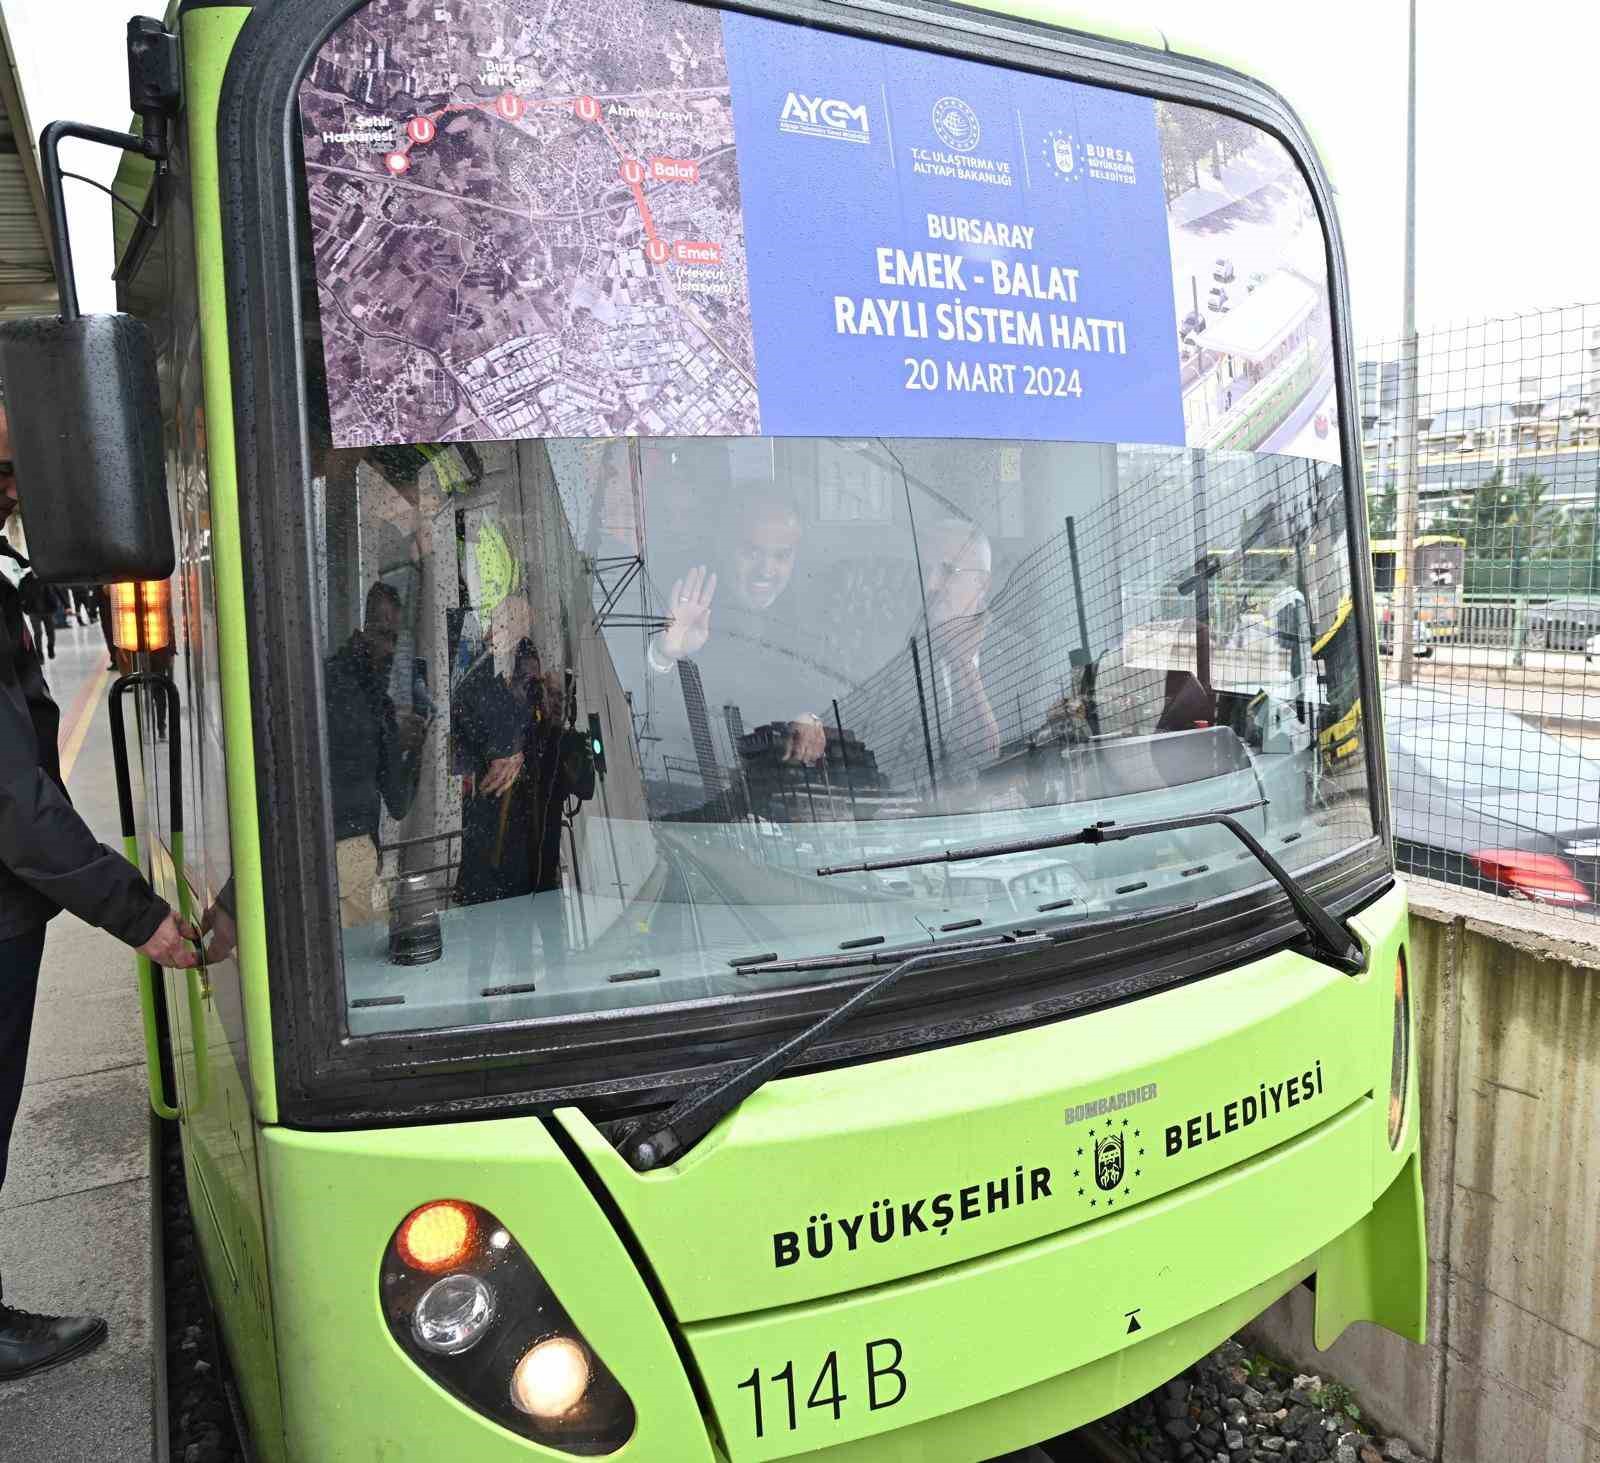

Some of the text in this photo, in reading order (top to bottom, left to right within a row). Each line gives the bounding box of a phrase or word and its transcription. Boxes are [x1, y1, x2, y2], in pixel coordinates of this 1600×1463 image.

[322, 130, 393, 144] Hastanesi
[1087, 143, 1134, 164] BURSA
[655, 163, 694, 178] Balat
[911, 147, 1009, 173] T.C. ULAŞTIRMA VE
[913, 162, 1012, 187] ALTYAPI BAKANLIĞI
[927, 213, 1034, 250] BURSARAY
[677, 244, 718, 260] Emek
[876, 248, 967, 291] EMEK
[991, 260, 1079, 303] BALAT
[834, 296, 1127, 354] RAYLI SİSTEM HATTI
[904, 358, 1083, 398] 20 MART 2024
[1064, 1083, 1157, 1125] BOMBARDIER
[773, 1060, 1322, 1268] BÜYÜKŞEHİR BELEDİYESİ
[737, 1337, 907, 1439] 114 B
